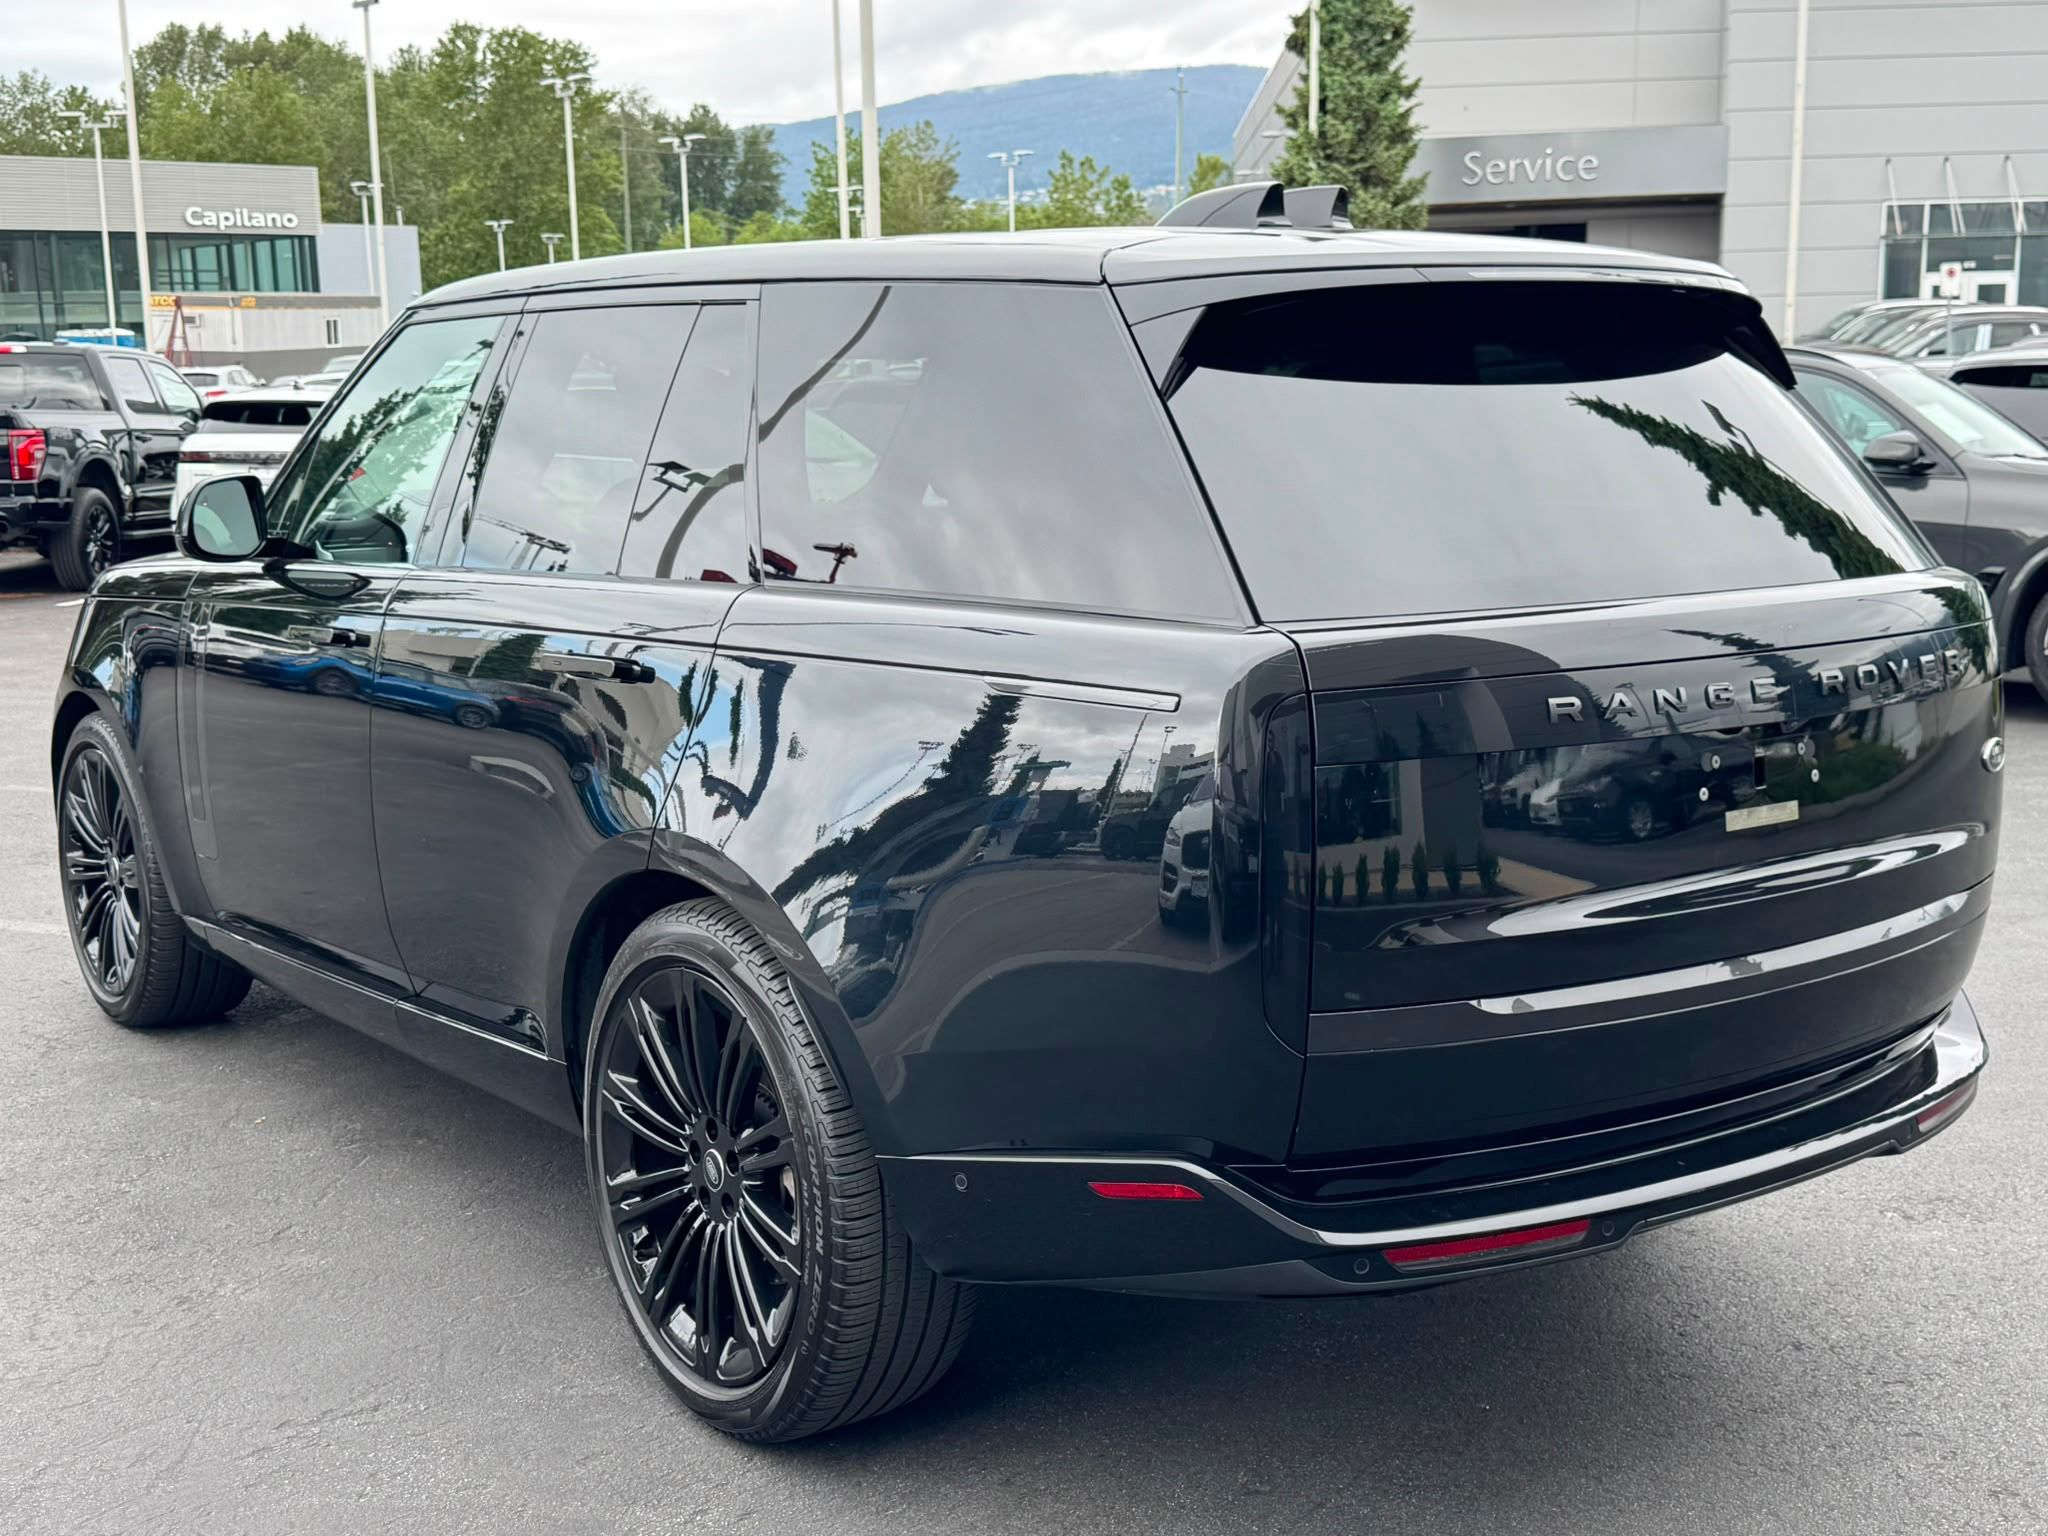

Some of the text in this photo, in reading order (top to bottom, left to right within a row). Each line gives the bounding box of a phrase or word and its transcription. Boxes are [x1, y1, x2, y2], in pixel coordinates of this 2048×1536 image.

[1462, 147, 1599, 185] Service
[185, 206, 298, 230] Capilano
[1548, 649, 1963, 725] RANGE ROVER
[807, 1264, 823, 1335] ZERO
